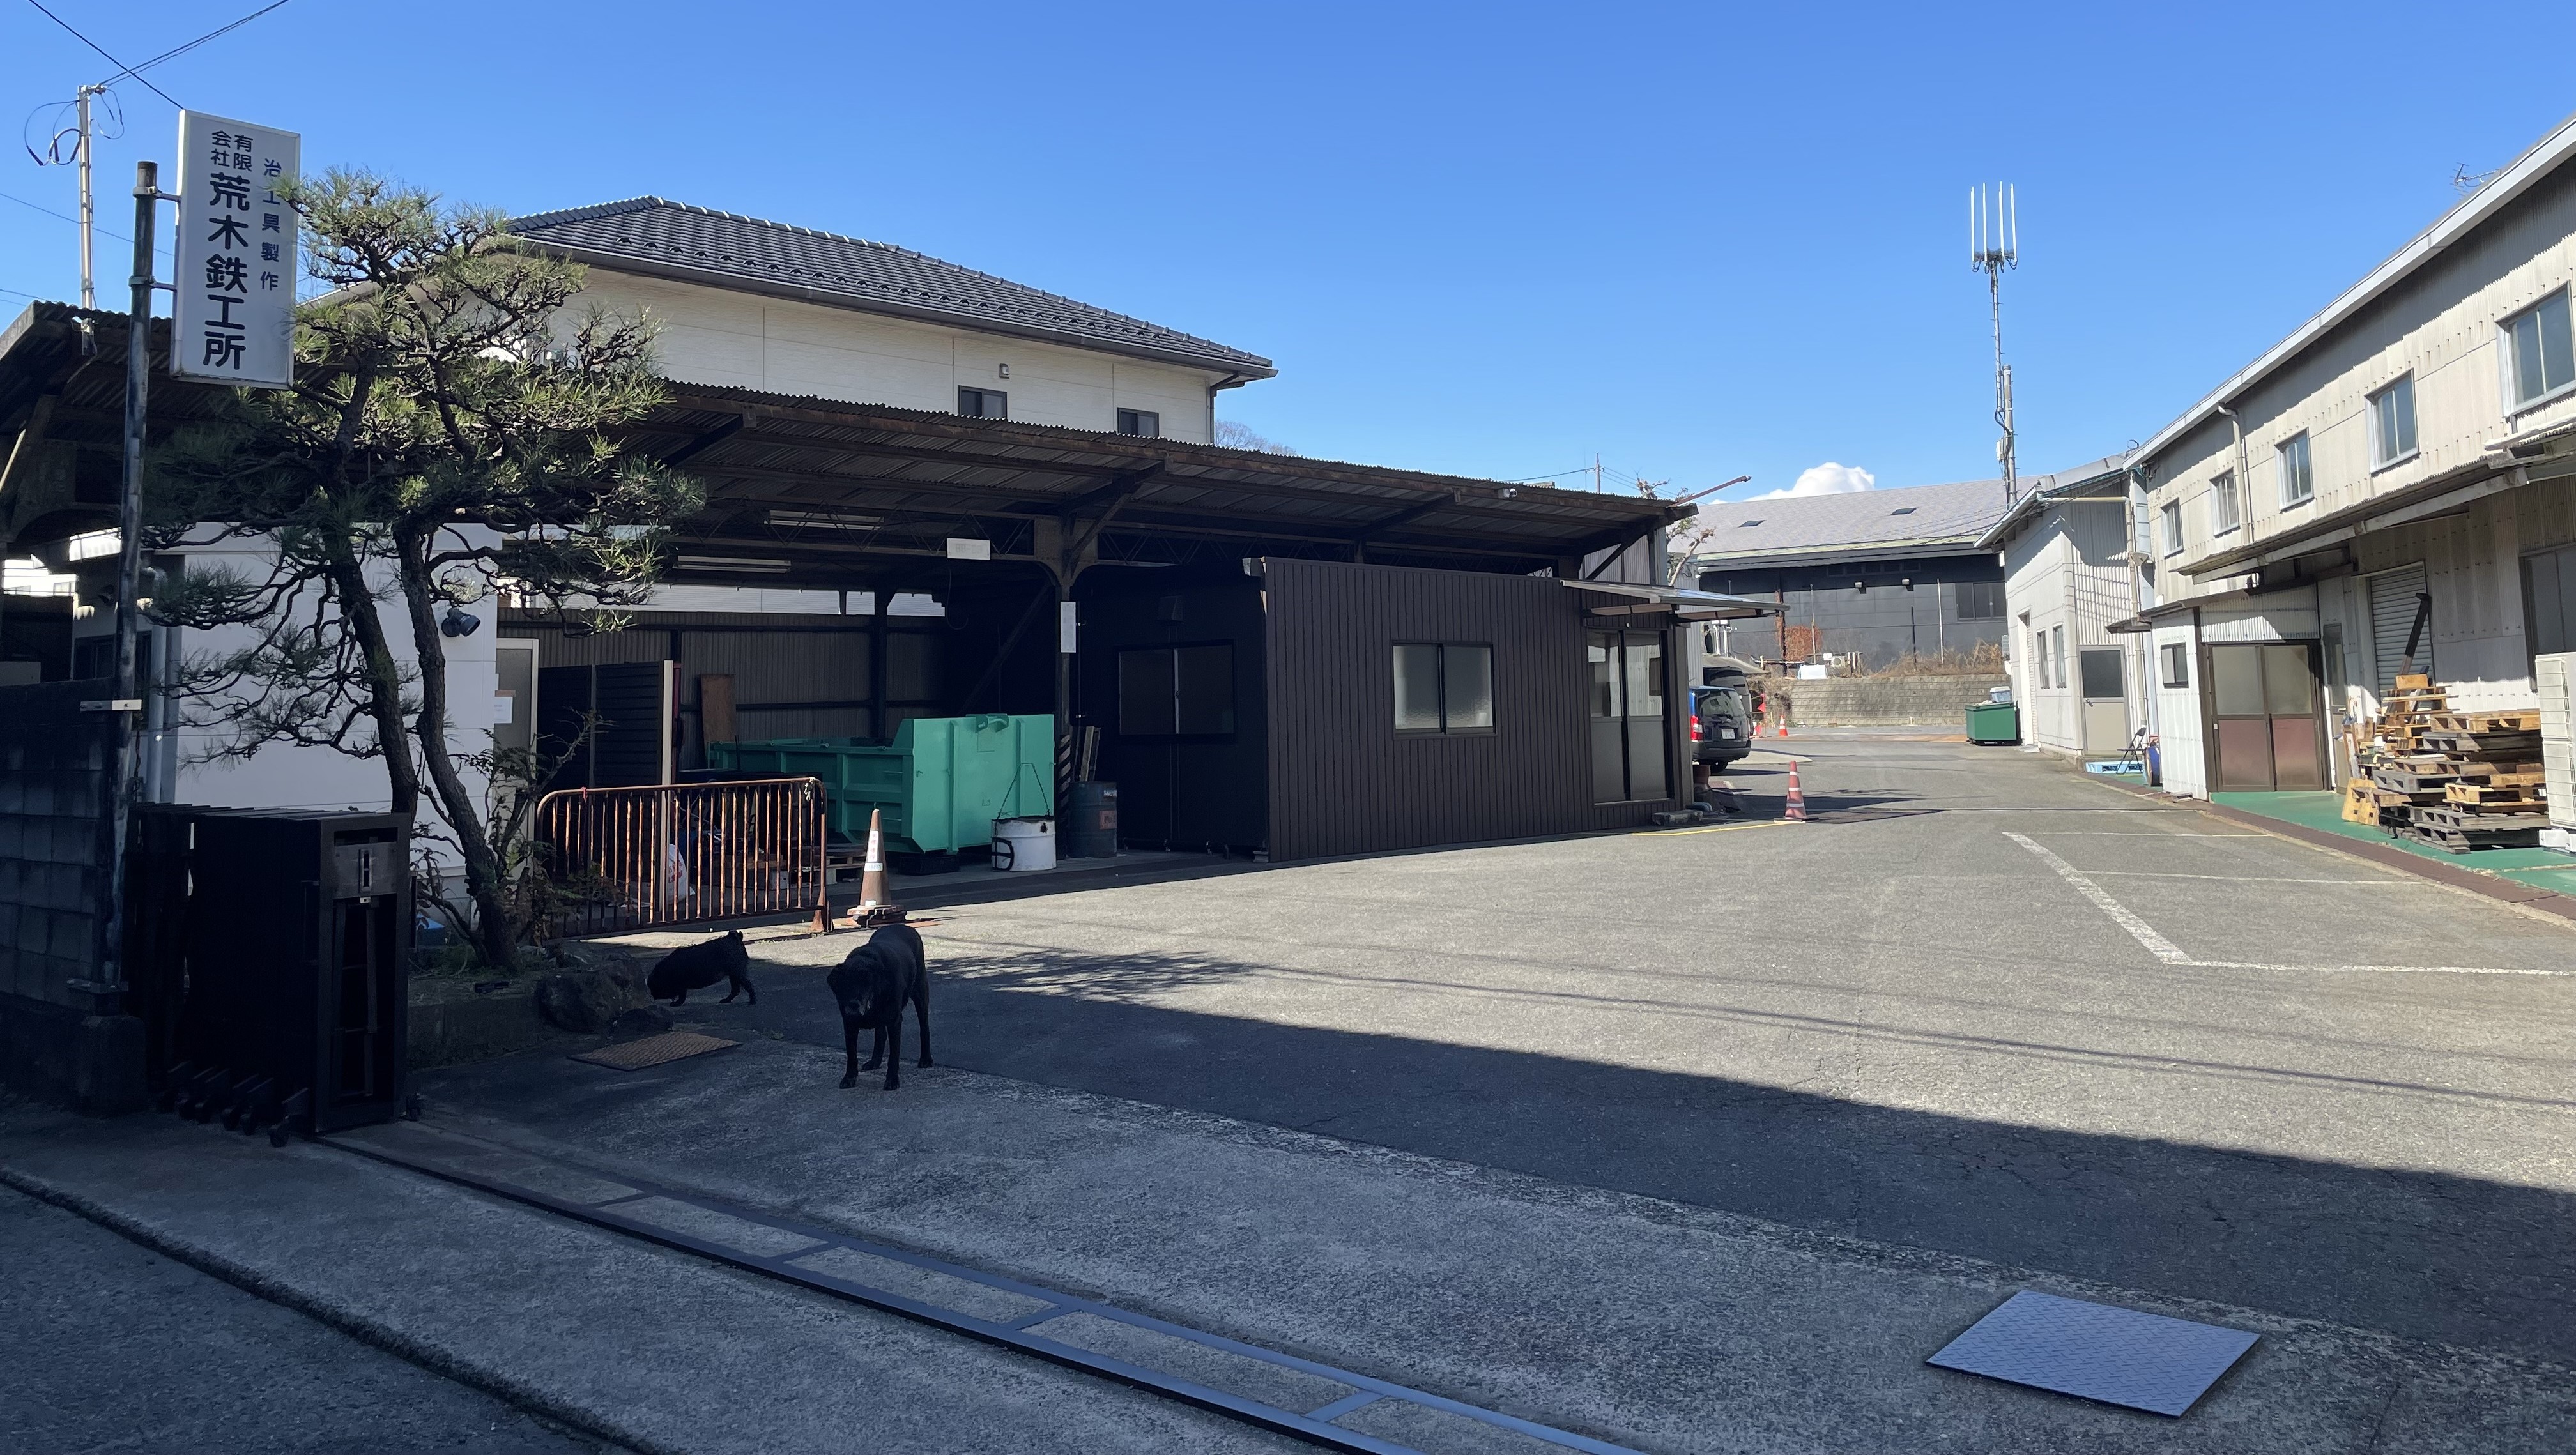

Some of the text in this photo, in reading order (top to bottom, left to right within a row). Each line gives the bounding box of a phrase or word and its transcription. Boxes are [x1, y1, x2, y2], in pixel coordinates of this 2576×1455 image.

[210, 130, 232, 167] 会社
[234, 134, 254, 172] 有限
[203, 172, 250, 370] 荒木鉄工所
